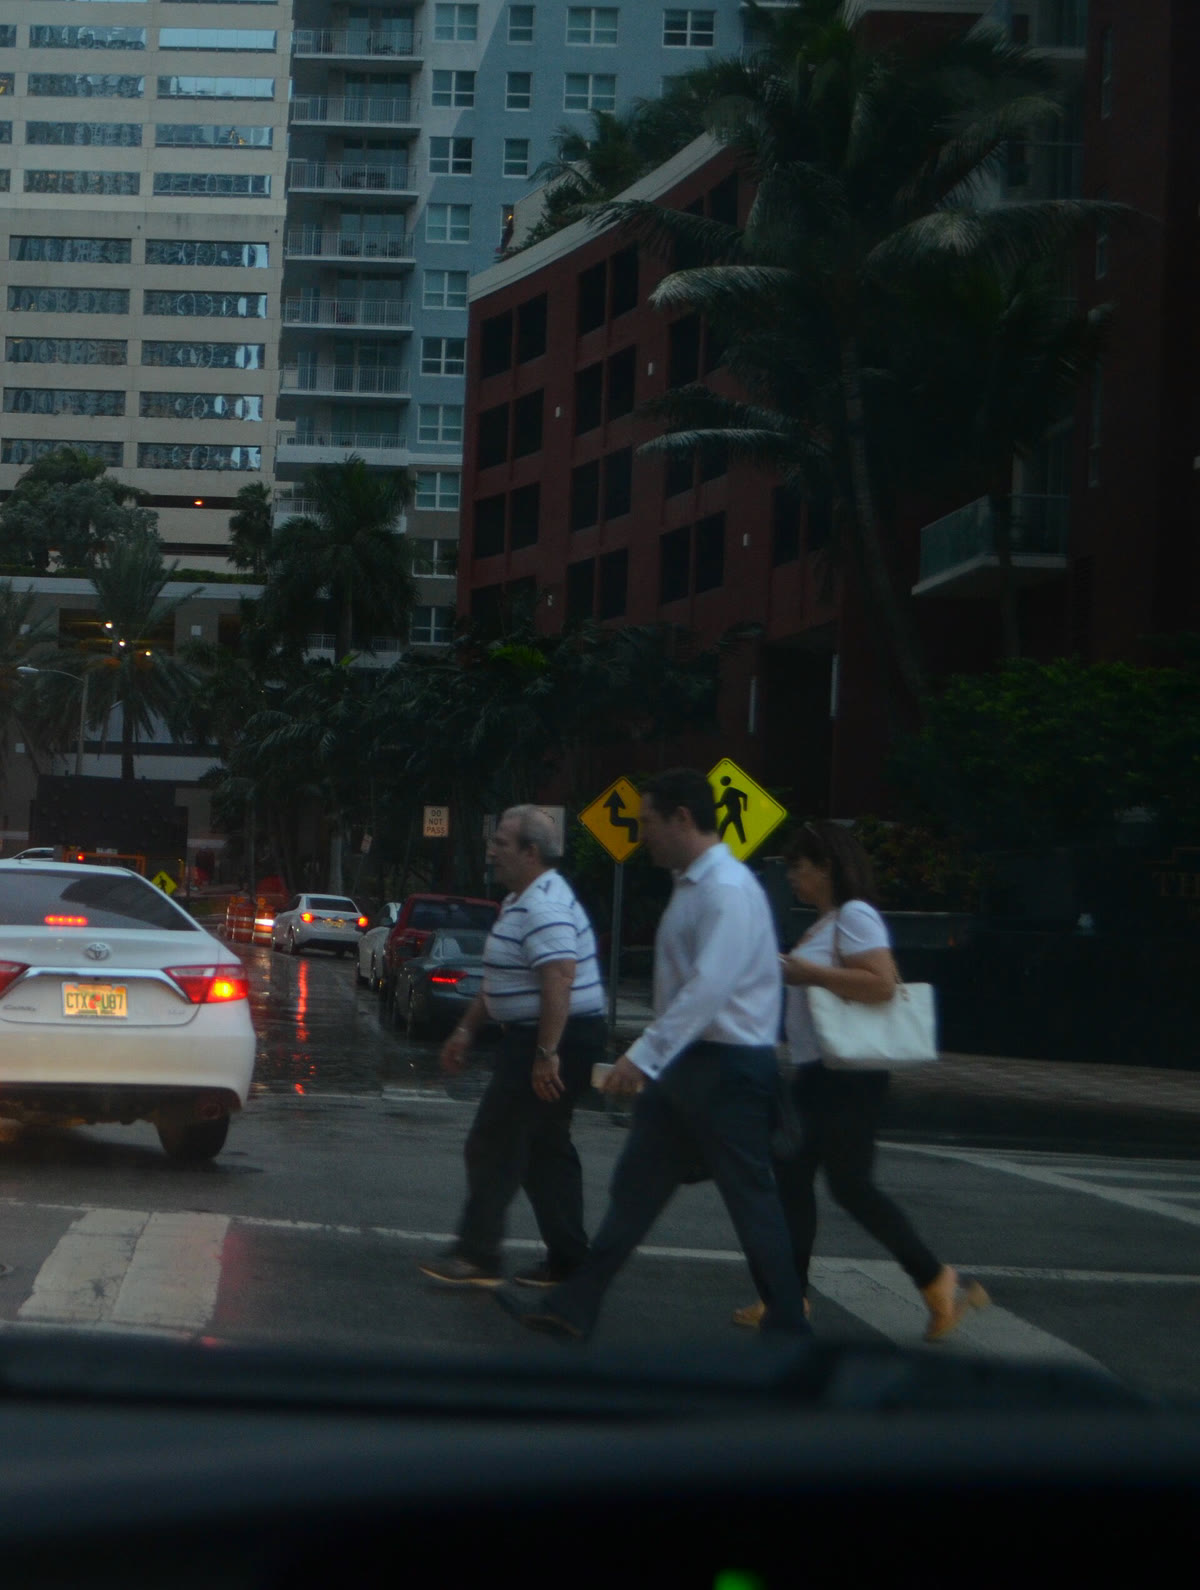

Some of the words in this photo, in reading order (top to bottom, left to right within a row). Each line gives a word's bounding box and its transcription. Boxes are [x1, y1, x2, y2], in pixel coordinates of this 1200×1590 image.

[431, 809, 442, 817] DO
[428, 818, 443, 826] NOT
[426, 826, 446, 835] PASS
